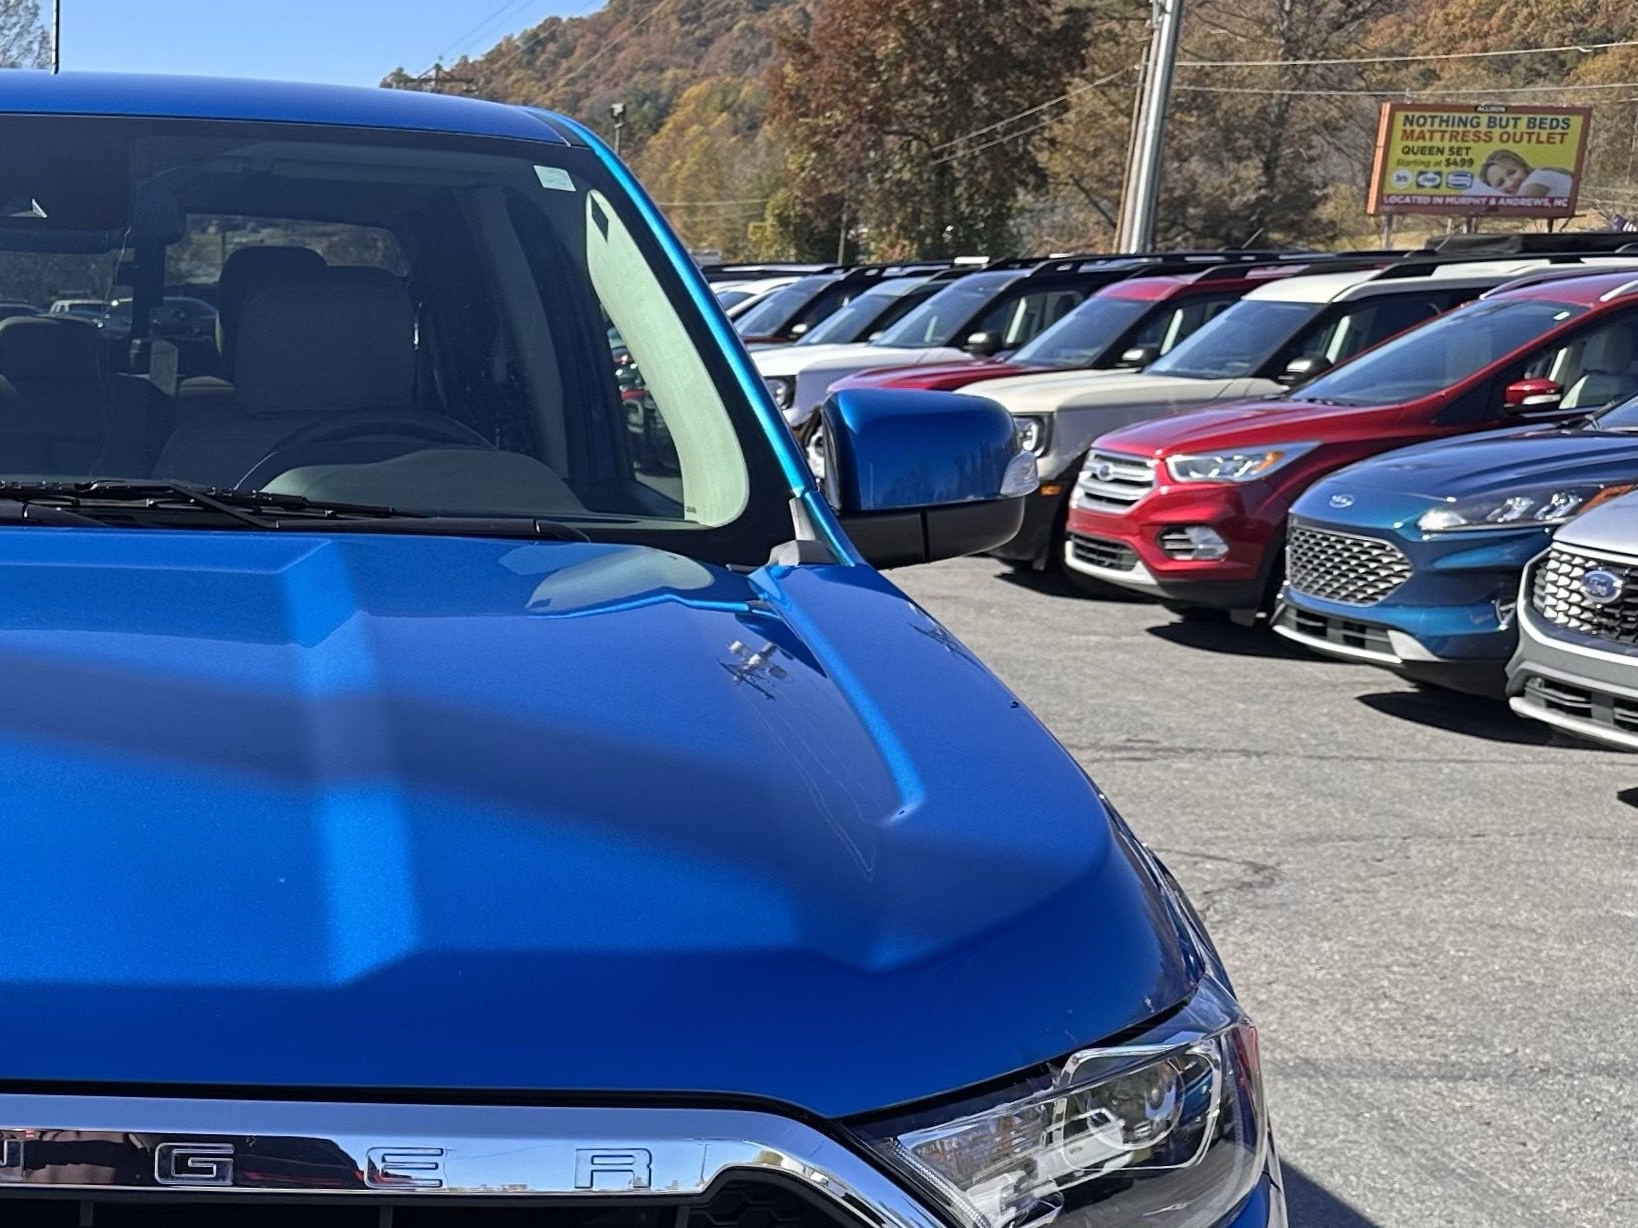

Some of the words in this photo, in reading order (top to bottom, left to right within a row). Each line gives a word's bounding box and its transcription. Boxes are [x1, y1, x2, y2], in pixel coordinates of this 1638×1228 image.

[1403, 114, 1481, 129] NOTHING
[1487, 115, 1522, 129] BUT
[1526, 116, 1571, 130] BEDS
[1400, 129, 1493, 143] MATTRESS
[1499, 131, 1568, 144] OUTLET
[1402, 145, 1444, 156] QUEEN
[1448, 146, 1471, 156] SET
[1444, 157, 1474, 168] $499
[1383, 195, 1431, 205] LOCATED
[1432, 196, 1443, 205] IN
[1445, 196, 1488, 206] MURPHY
[1554, 198, 1569, 207] NC
